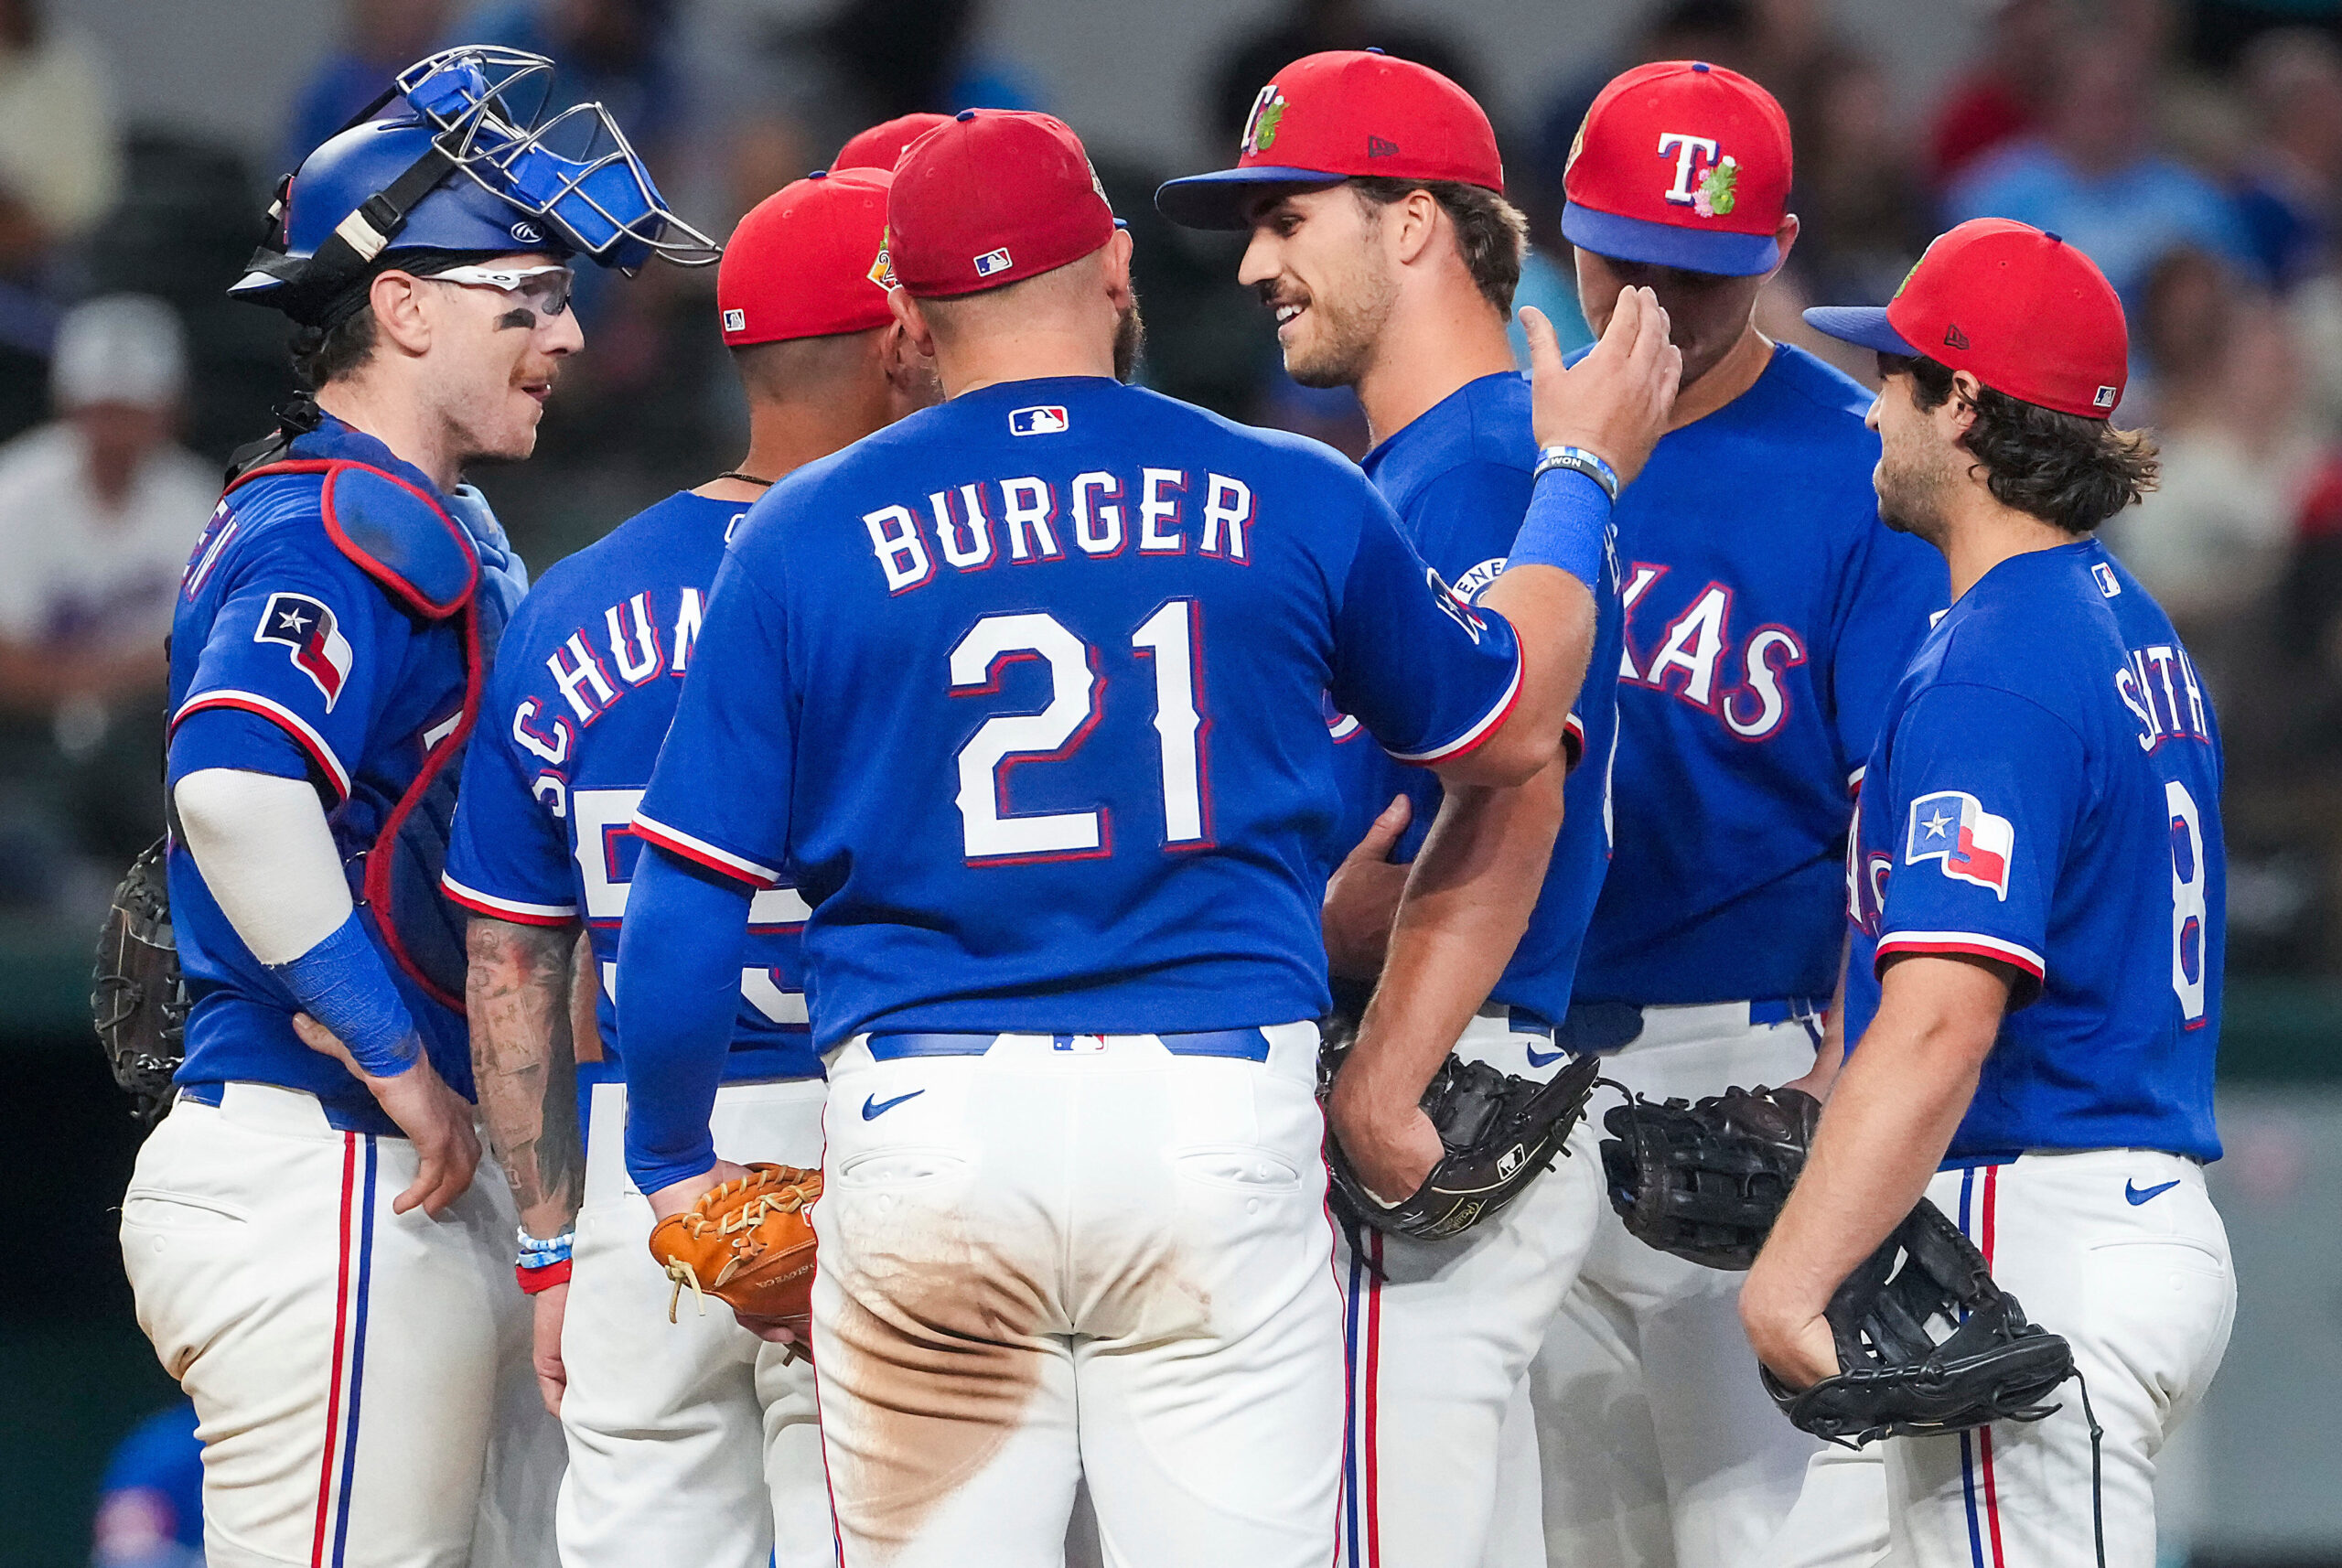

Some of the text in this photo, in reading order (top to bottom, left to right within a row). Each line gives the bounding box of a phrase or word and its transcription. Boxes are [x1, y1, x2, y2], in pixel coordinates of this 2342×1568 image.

[1658, 133, 1720, 207] T
[1551, 456, 1582, 467] WON
[862, 467, 1256, 596] BURGER
[946, 598, 1215, 869] 21
[2165, 780, 2207, 1030] 8
